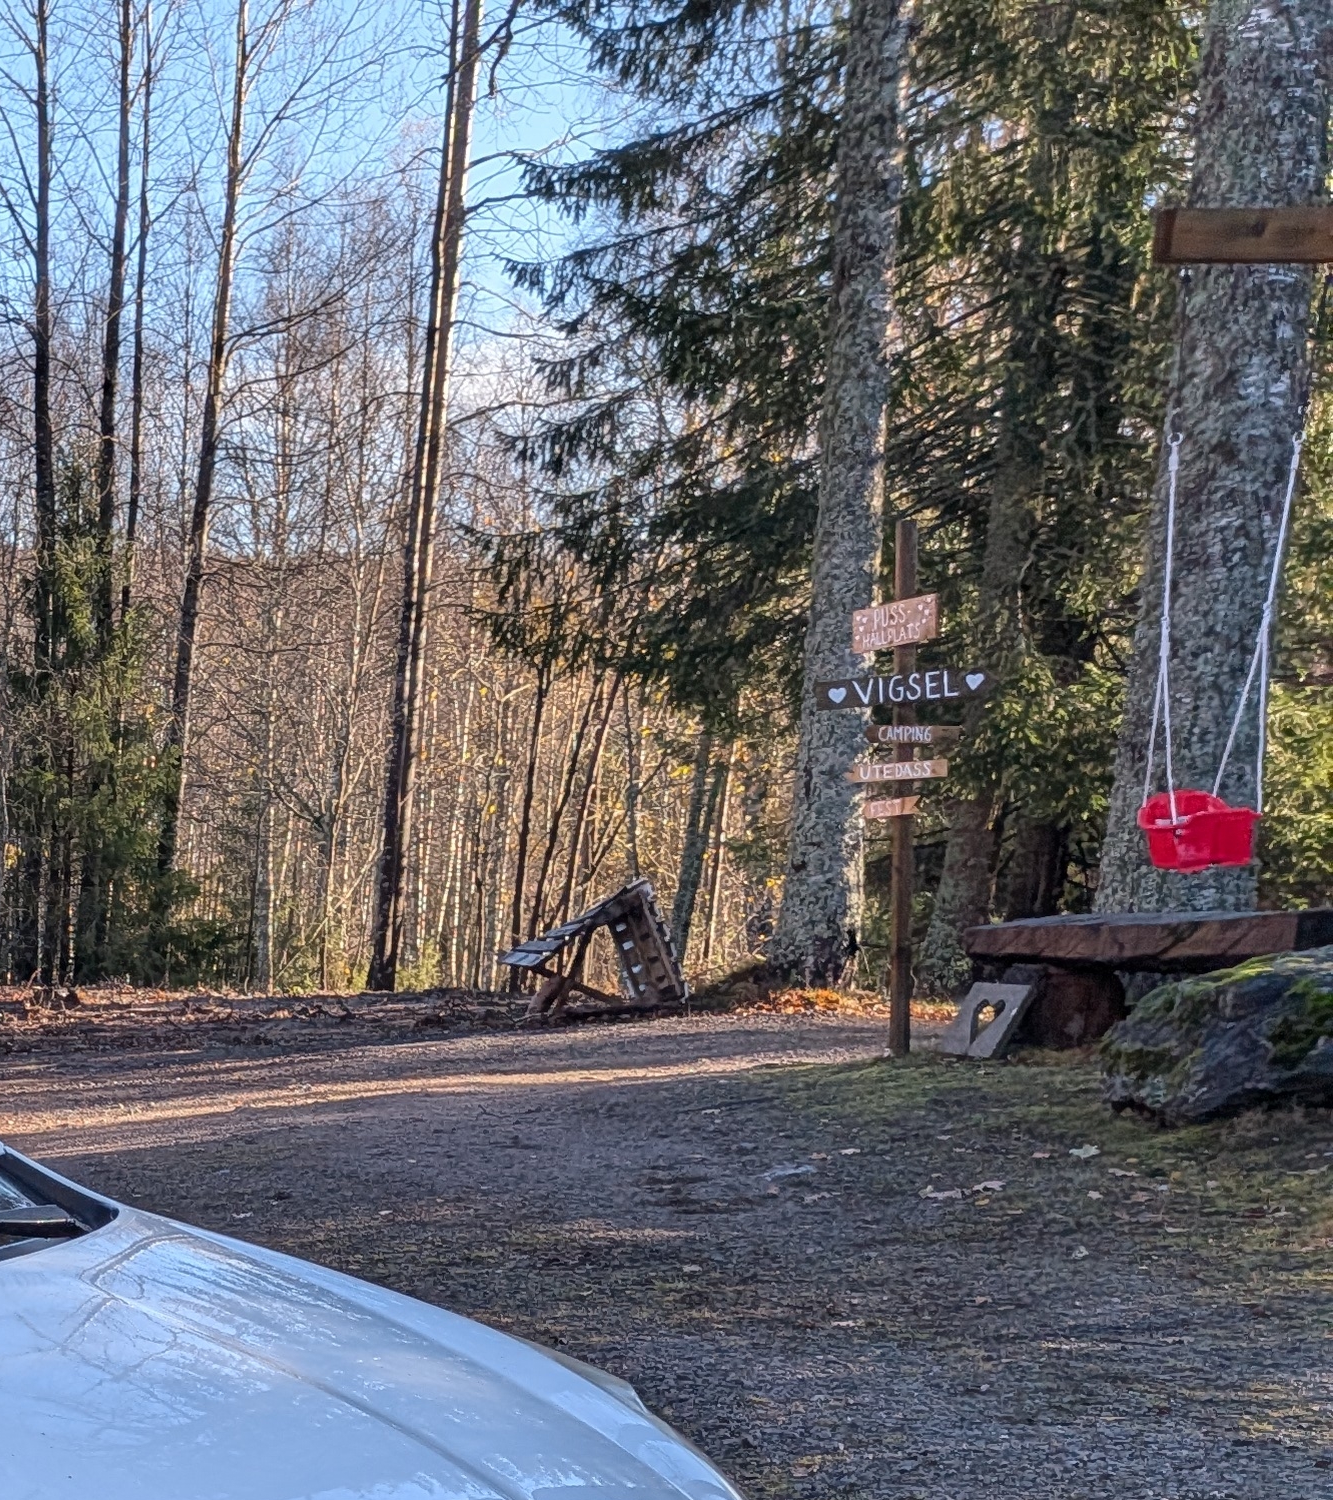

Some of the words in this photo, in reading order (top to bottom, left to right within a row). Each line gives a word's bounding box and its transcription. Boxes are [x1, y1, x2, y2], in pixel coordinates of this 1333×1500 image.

[851, 669, 960, 704] VIGSEL
[878, 725, 932, 742] CAMPING
[859, 761, 932, 780] UTEDASS
[870, 800, 902, 817] FEST
